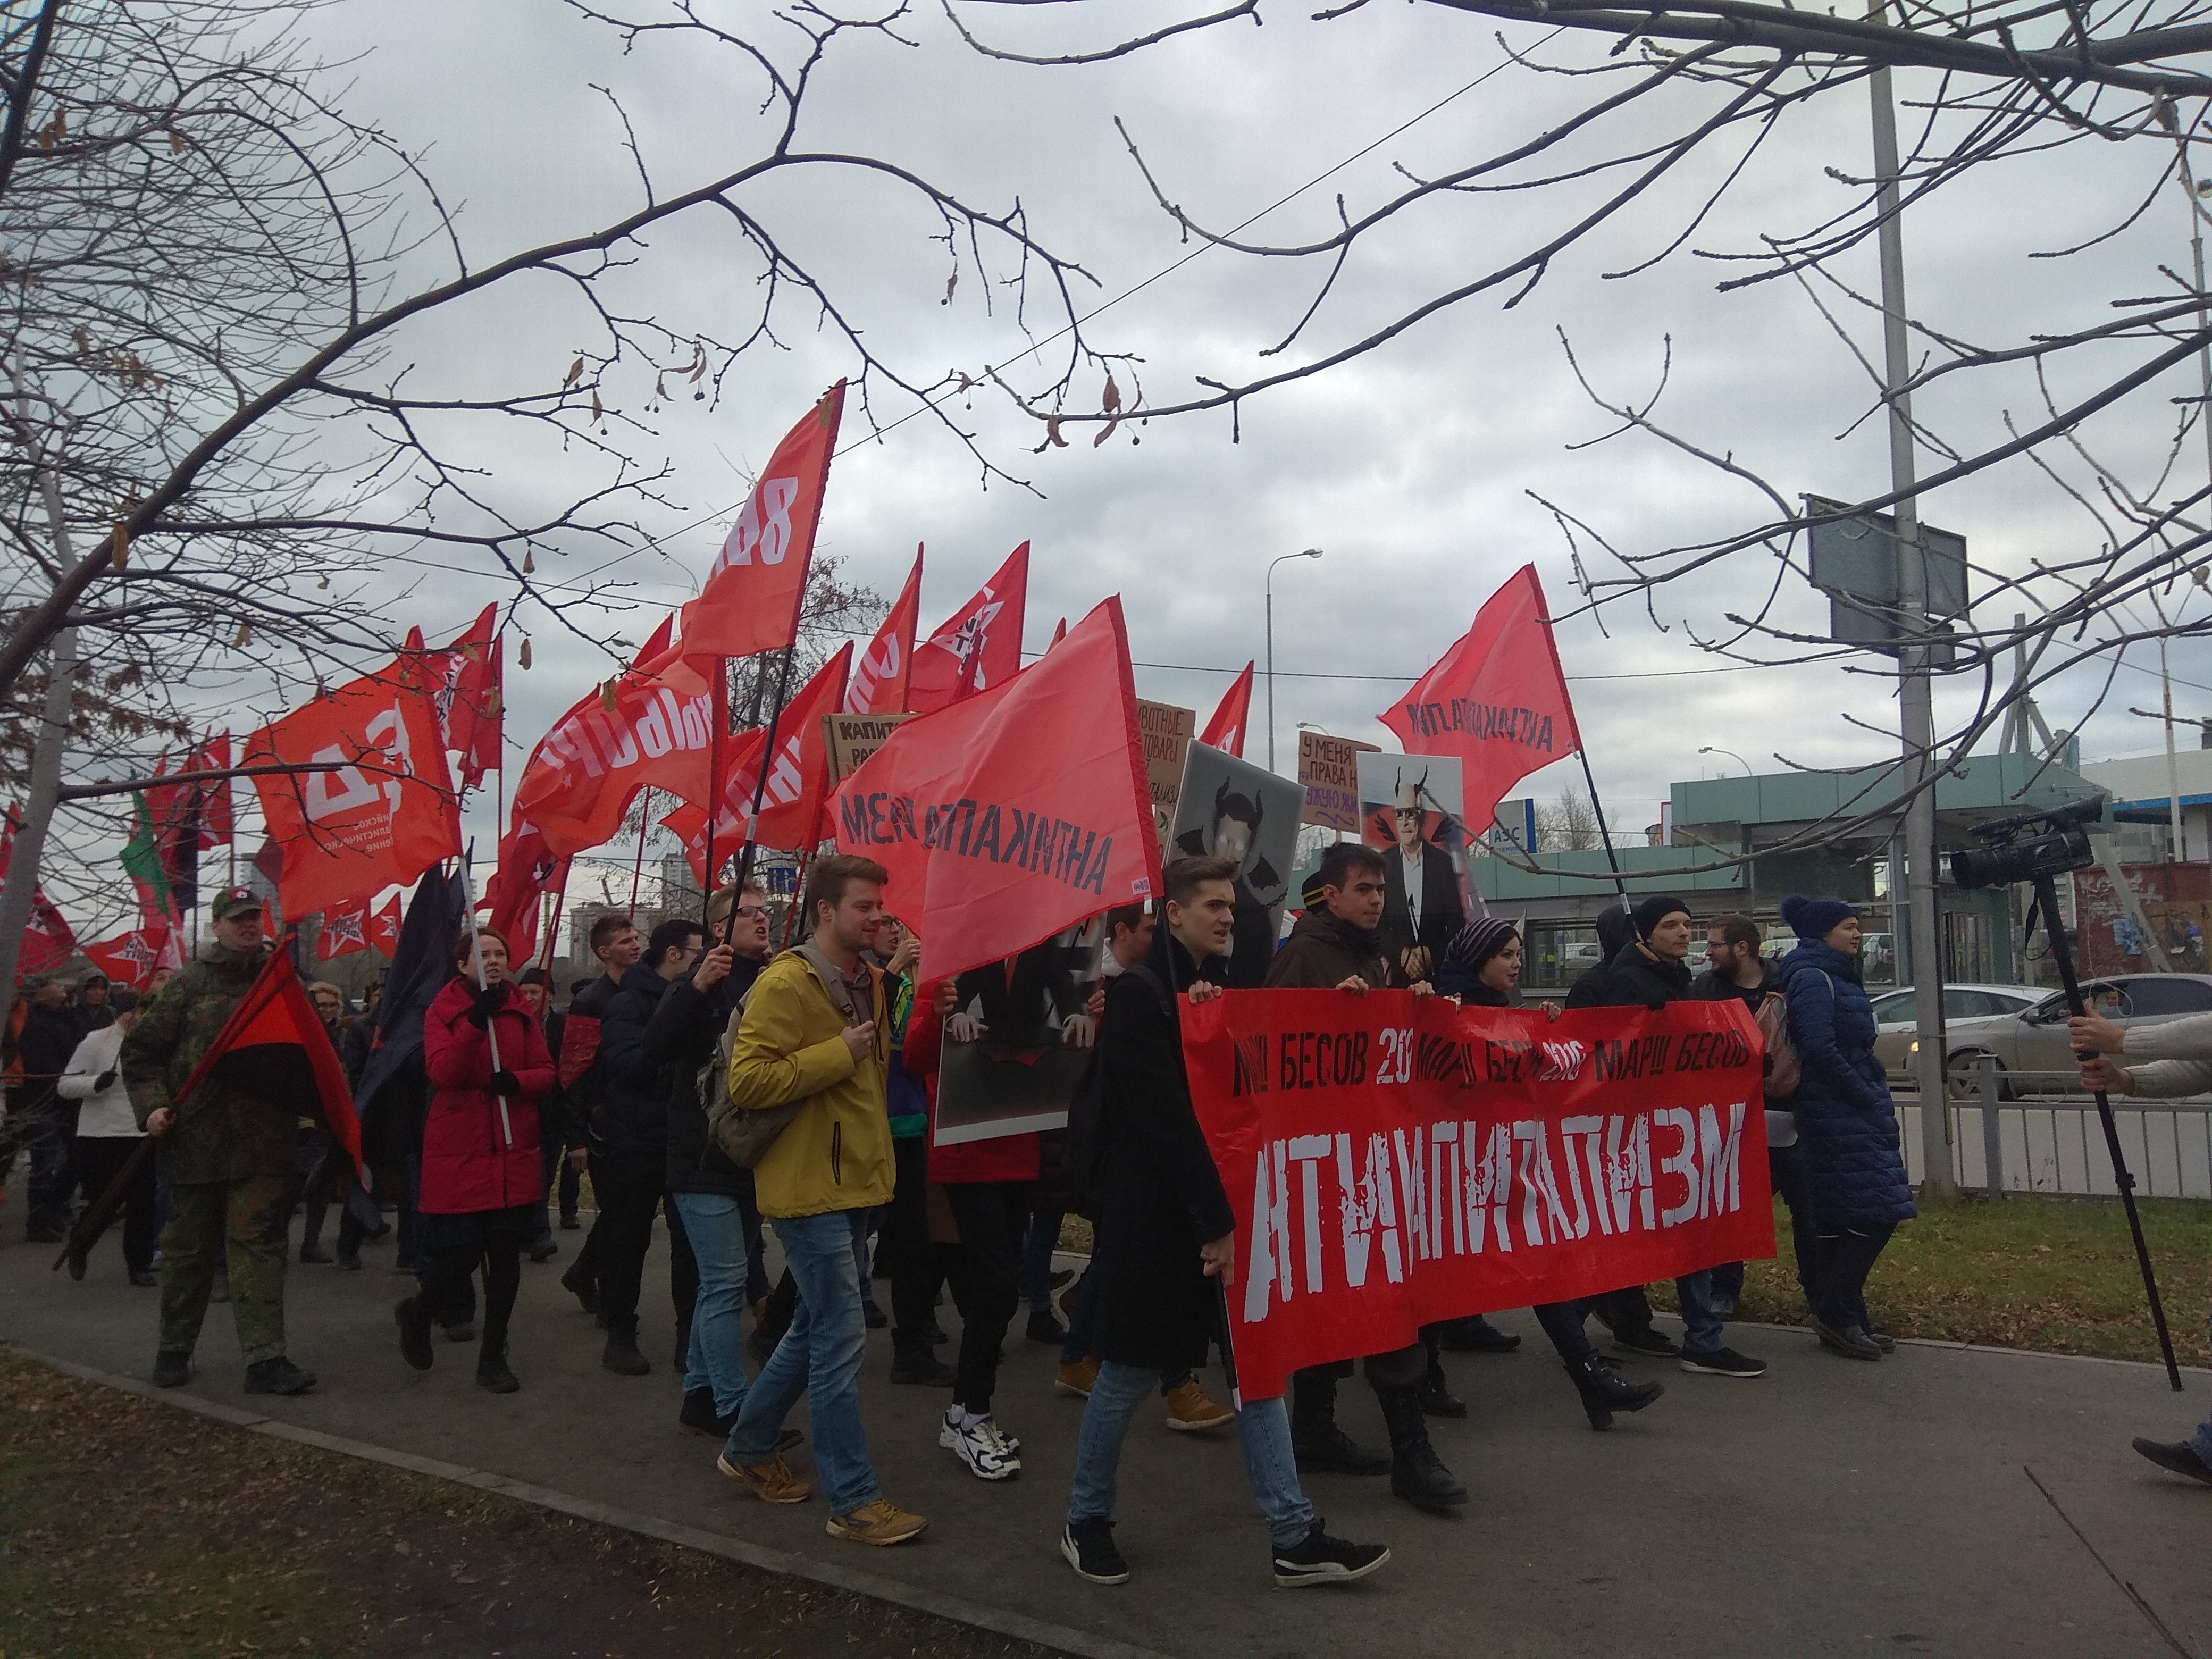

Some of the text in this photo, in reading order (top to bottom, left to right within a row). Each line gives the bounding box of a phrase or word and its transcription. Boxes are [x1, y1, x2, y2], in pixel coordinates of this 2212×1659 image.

[1138, 705, 1184, 736] ВОТНЫЕ
[1144, 734, 1178, 763] ТОВАРЫ
[1303, 736, 1352, 766] У МЕНЯ
[1310, 761, 1358, 790] ПРАВА Н
[1306, 785, 1359, 815] УЖУЮ ЖИ
[1280, 1030, 1369, 1091] БЕСОВ
[1595, 1034, 1673, 1082] МАРШ
[1674, 1029, 1751, 1073] БЕСОВ
